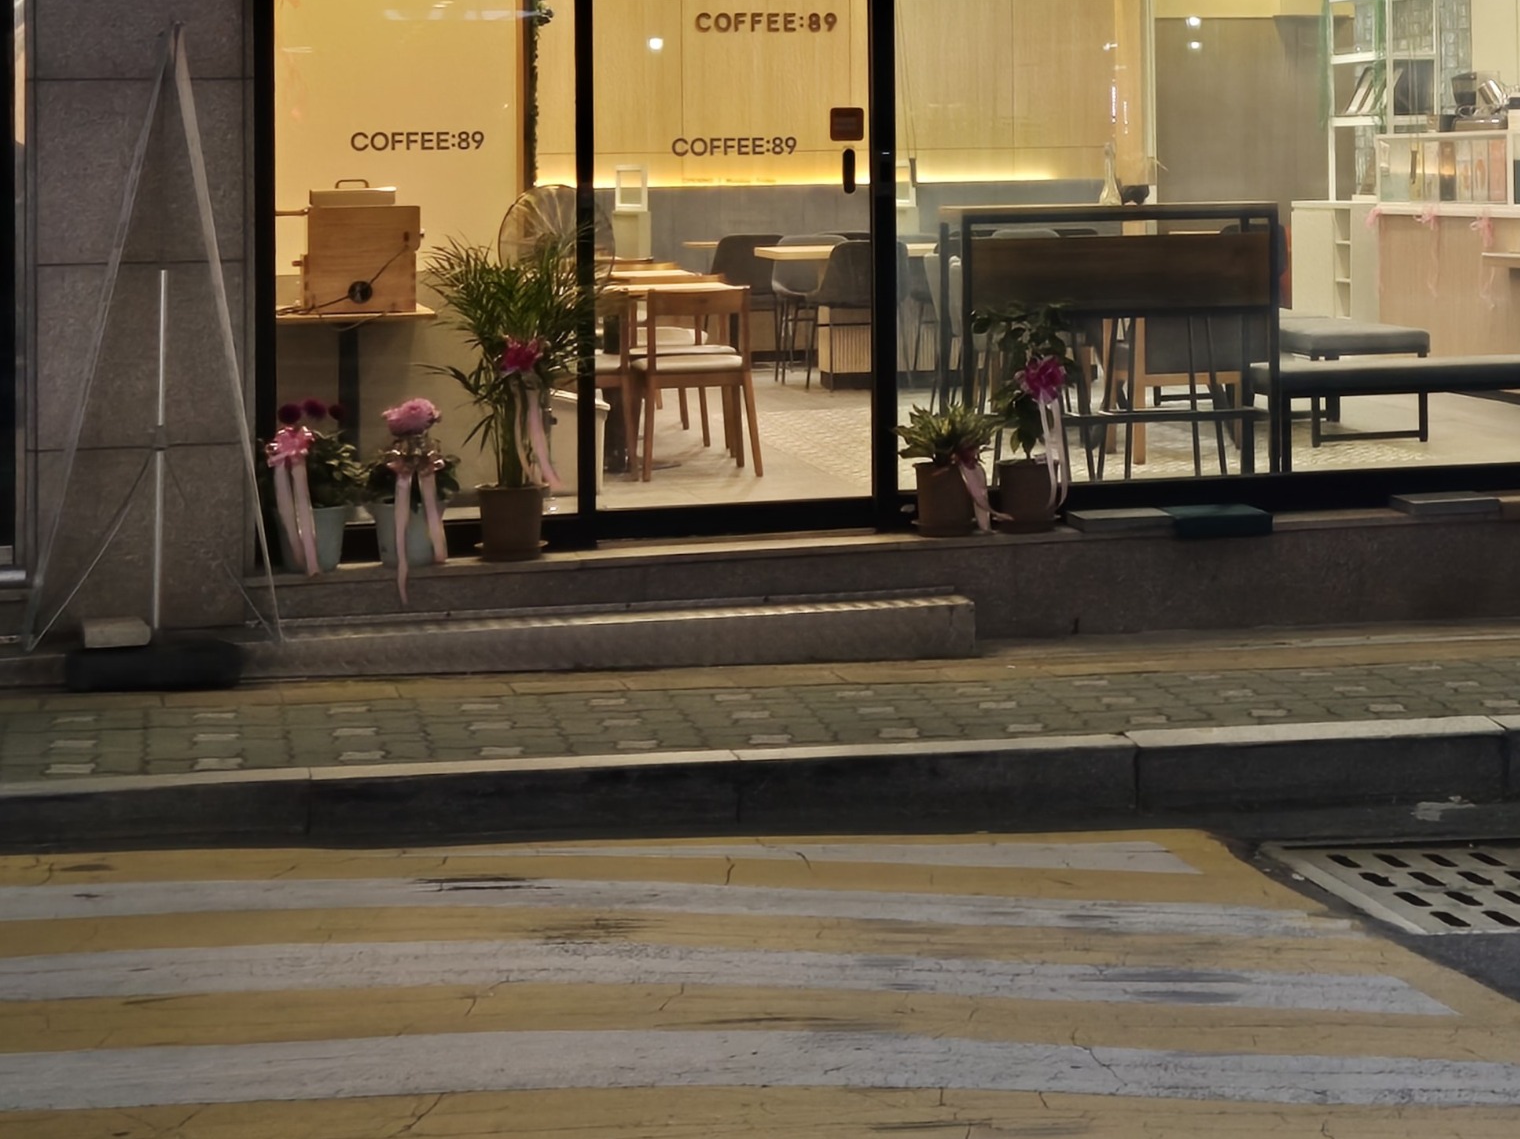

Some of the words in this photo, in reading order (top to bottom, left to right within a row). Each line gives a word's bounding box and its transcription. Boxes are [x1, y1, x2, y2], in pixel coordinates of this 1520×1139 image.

[695, 12, 838, 33] COFFEE:89
[350, 131, 485, 151] COFFEE:89
[671, 137, 797, 157] COFFEE:89
